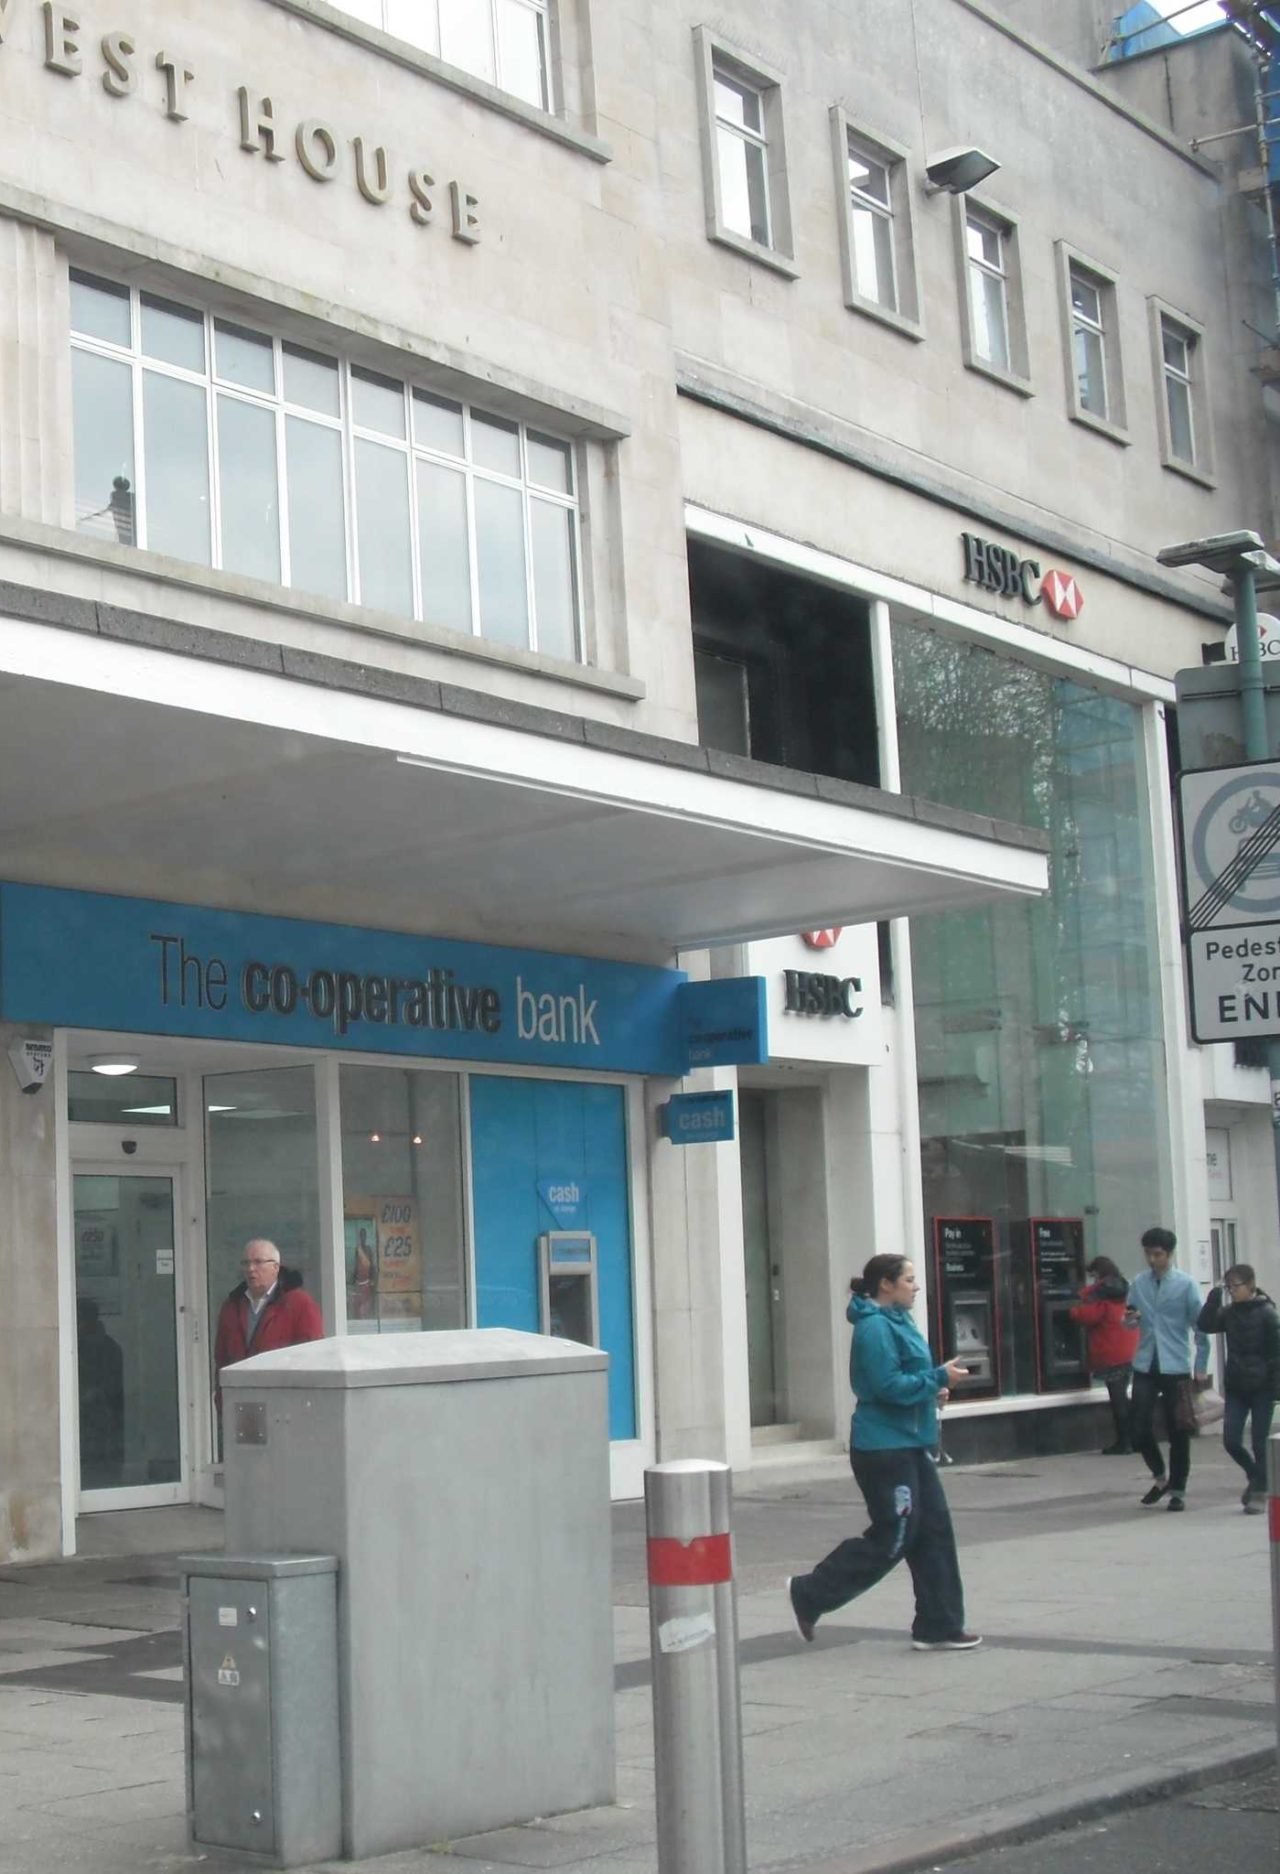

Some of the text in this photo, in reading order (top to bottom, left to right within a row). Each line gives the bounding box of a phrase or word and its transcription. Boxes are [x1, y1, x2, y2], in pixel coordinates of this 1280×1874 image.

[236, 84, 481, 245] HOUSE
[961, 531, 1042, 607] HSBC
[1230, 639, 1280, 661] HBC
[1206, 938, 1280, 961] Pedes
[149, 933, 600, 1046] The co-operative bank
[783, 969, 864, 1018] HSBC
[1219, 989, 1280, 1023] EN
[678, 1107, 726, 1130] cash
[549, 1182, 580, 1203] cash
[384, 1236, 412, 1257] £25
